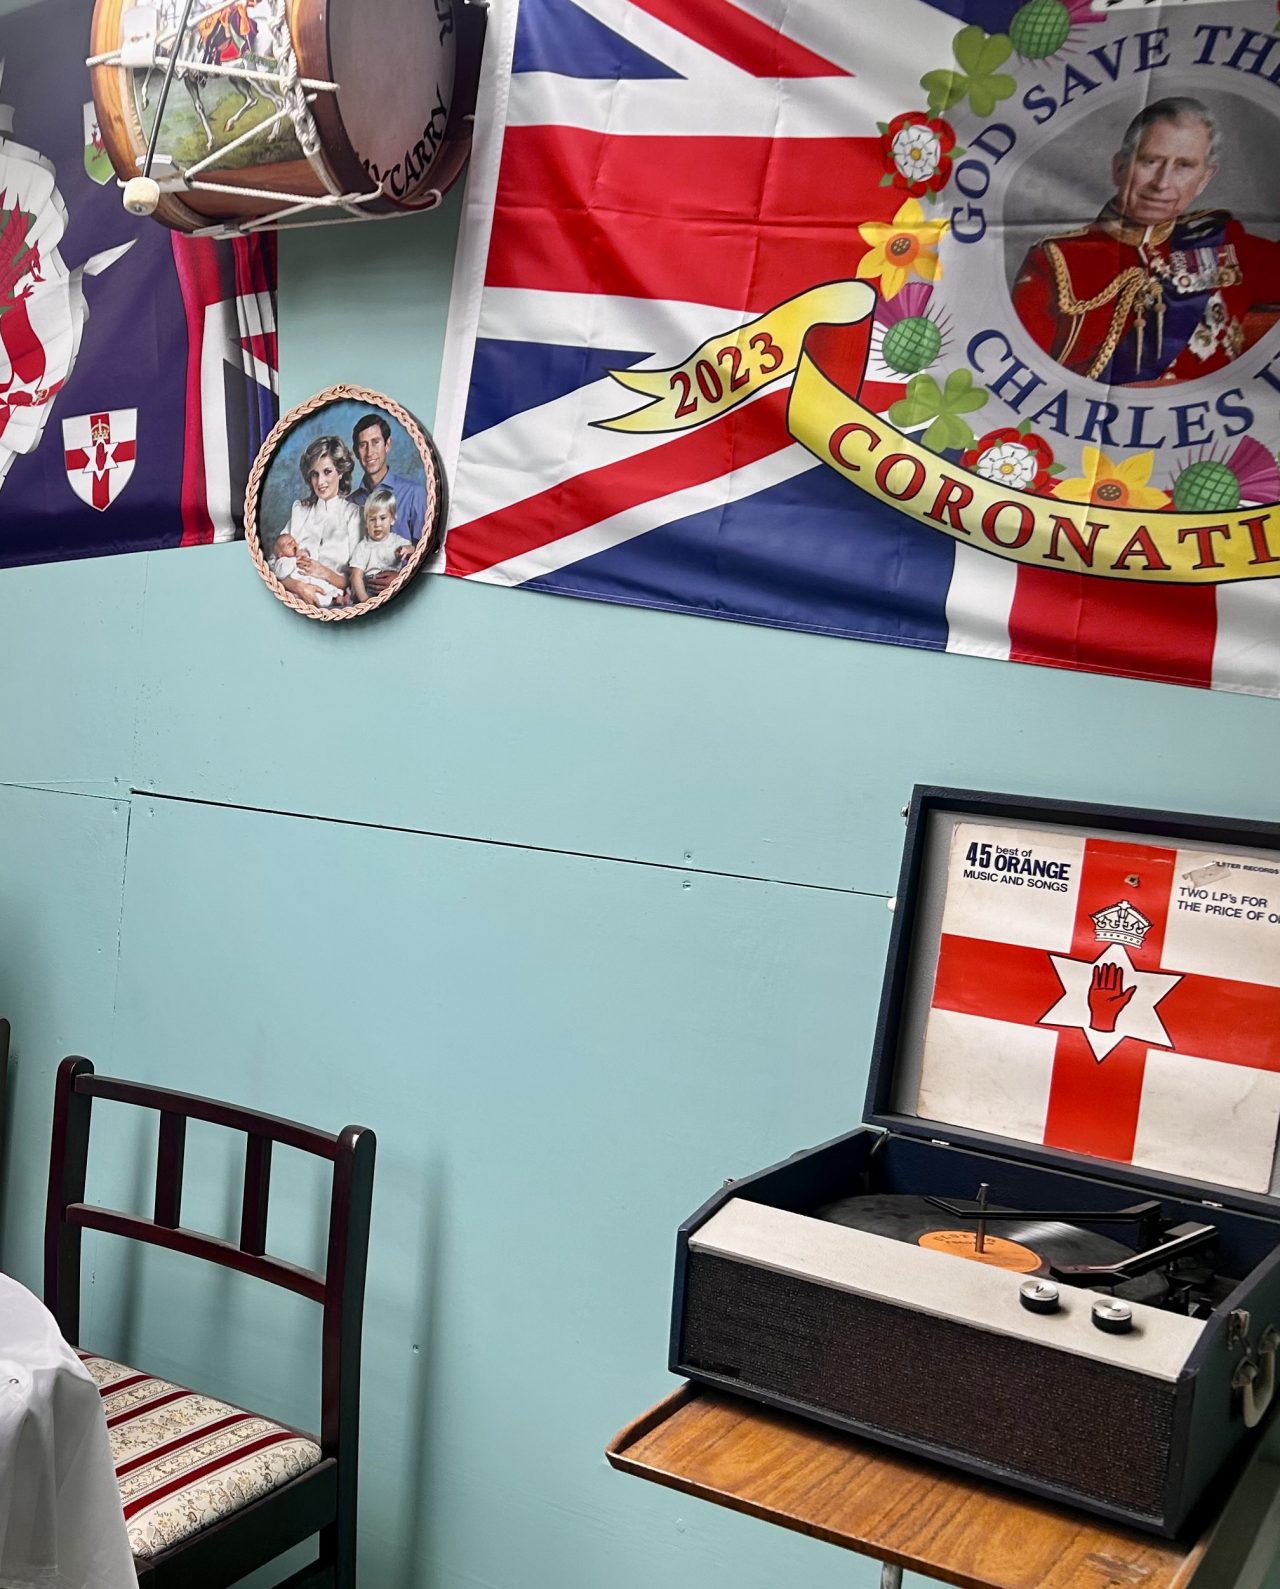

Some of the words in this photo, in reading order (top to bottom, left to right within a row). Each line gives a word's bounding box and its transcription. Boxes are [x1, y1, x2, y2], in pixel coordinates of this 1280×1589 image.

[390, 82, 448, 197] CARRY
[949, 121, 1018, 246] GOD
[1020, 26, 1171, 126] SAVE
[1192, 24, 1280, 86] TH
[669, 331, 785, 420] 2023
[965, 328, 1255, 449] CHARLES
[827, 422, 1280, 573] CORONATI
[966, 841, 992, 869] 45
[995, 845, 1020, 857] best
[1021, 847, 1032, 858] of
[994, 855, 1071, 881] ORANGE
[1212, 860, 1241, 871] LSTER
[962, 869, 999, 883] MUSIC
[1000, 874, 1024, 887] AND
[1026, 878, 1069, 893] SONGS
[1177, 900, 1202, 912] THE
[1205, 904, 1243, 918] PRICE
[1245, 910, 1263, 921] OF
[1178, 887, 1209, 899] TWO
[1211, 892, 1237, 904] LP's
[1241, 896, 1268, 908] FOR
